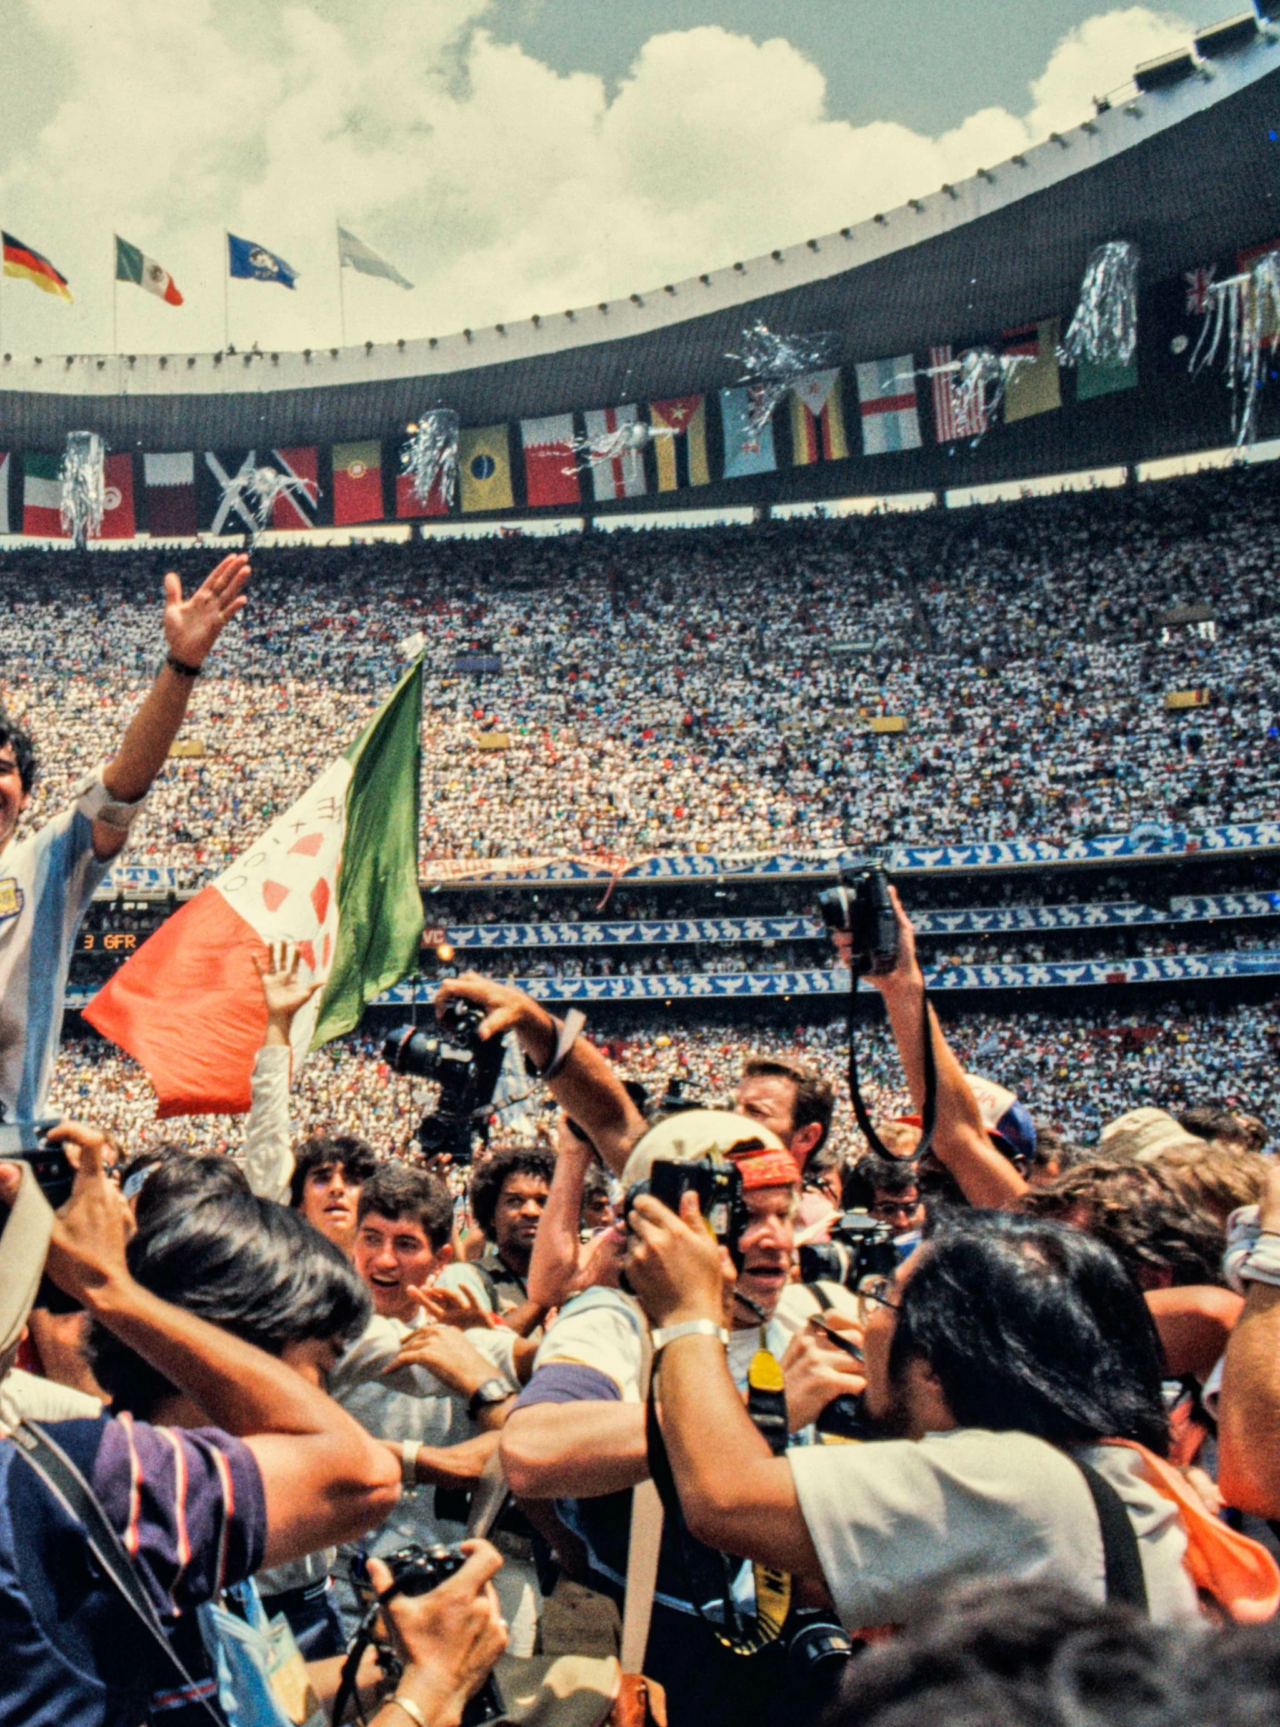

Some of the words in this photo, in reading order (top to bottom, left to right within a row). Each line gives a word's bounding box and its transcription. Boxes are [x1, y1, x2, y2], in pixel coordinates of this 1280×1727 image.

[83, 934, 95, 950] 3
[103, 934, 137, 950] GFR
[422, 929, 444, 944] VC
